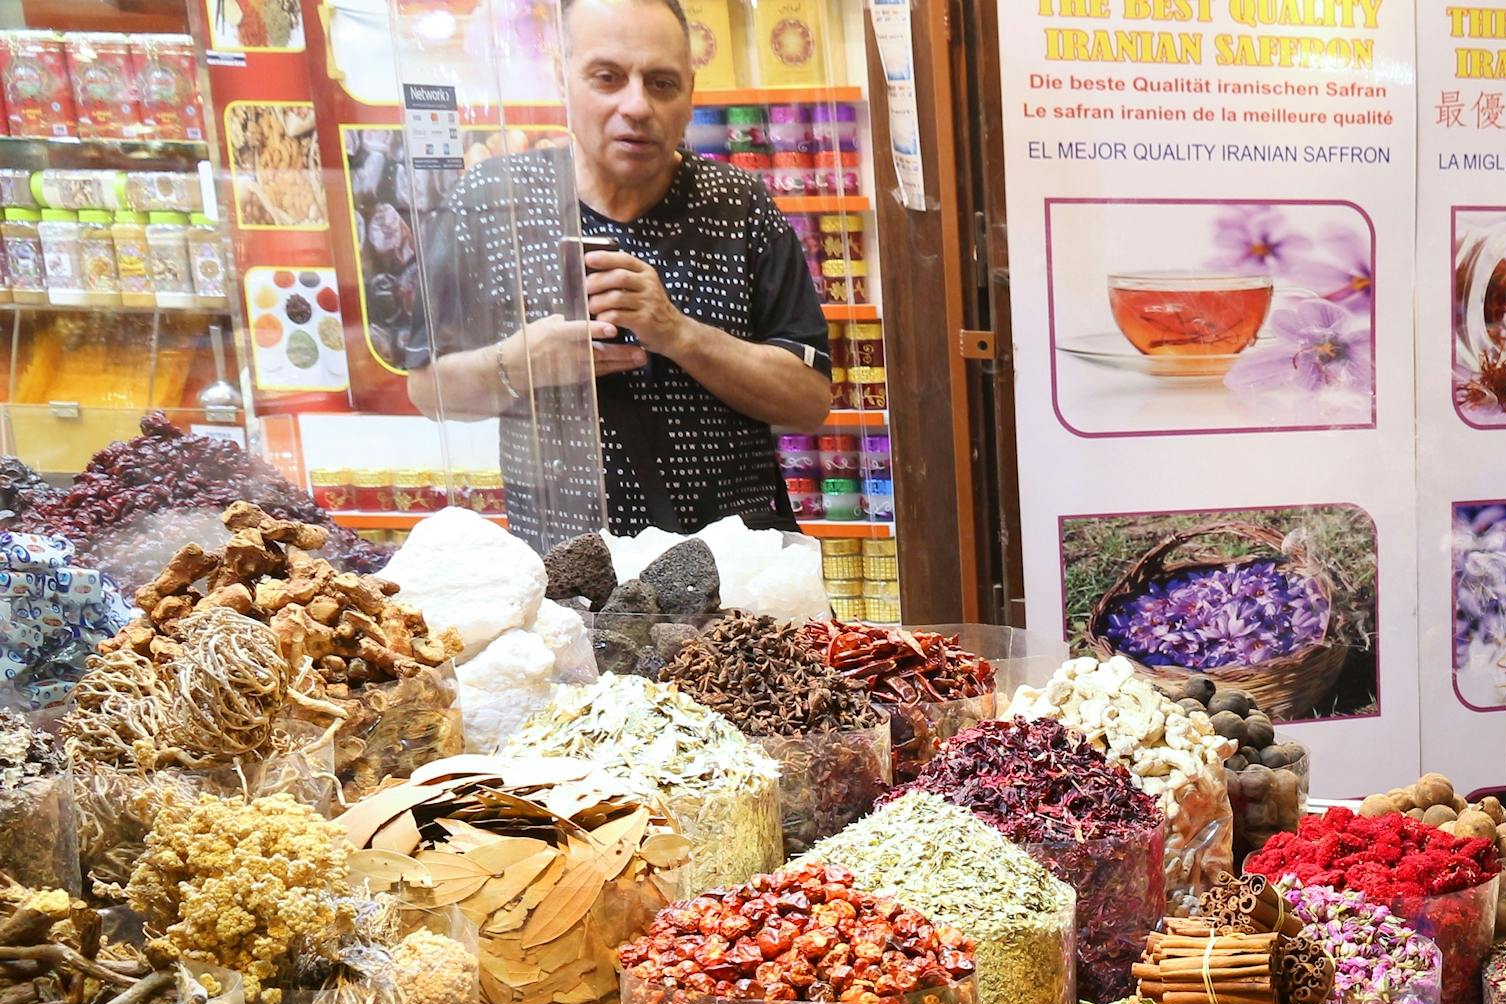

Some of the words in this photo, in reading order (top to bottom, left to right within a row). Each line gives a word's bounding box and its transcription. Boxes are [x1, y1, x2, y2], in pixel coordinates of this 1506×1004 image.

[1123, 0, 1213, 23] BEST
[1229, 0, 1383, 29] QUALITY
[1044, 28, 1203, 64] IRANIAN
[1215, 33, 1375, 69] SAFFRON
[410, 87, 445, 101] Network
[1030, 74, 1063, 90] Die
[1070, 75, 1126, 91] beste
[1133, 77, 1211, 93] Qualität
[1218, 79, 1319, 96] iranischen
[1326, 81, 1387, 98] Safran
[1023, 103, 1047, 118] Le
[1053, 103, 1114, 119] safran
[1121, 105, 1186, 121] iranien
[1193, 107, 1215, 121] de
[1222, 107, 1237, 122] la
[1243, 108, 1327, 124] meilleure
[1333, 110, 1393, 127] qualité
[1028, 141, 1052, 159] EL
[1058, 142, 1127, 160] MEJOR
[1134, 143, 1215, 161] QUALITY
[1222, 144, 1297, 162] IRANIAN
[1303, 145, 1390, 164] SAFFRON
[1439, 153, 1459, 170] LA
